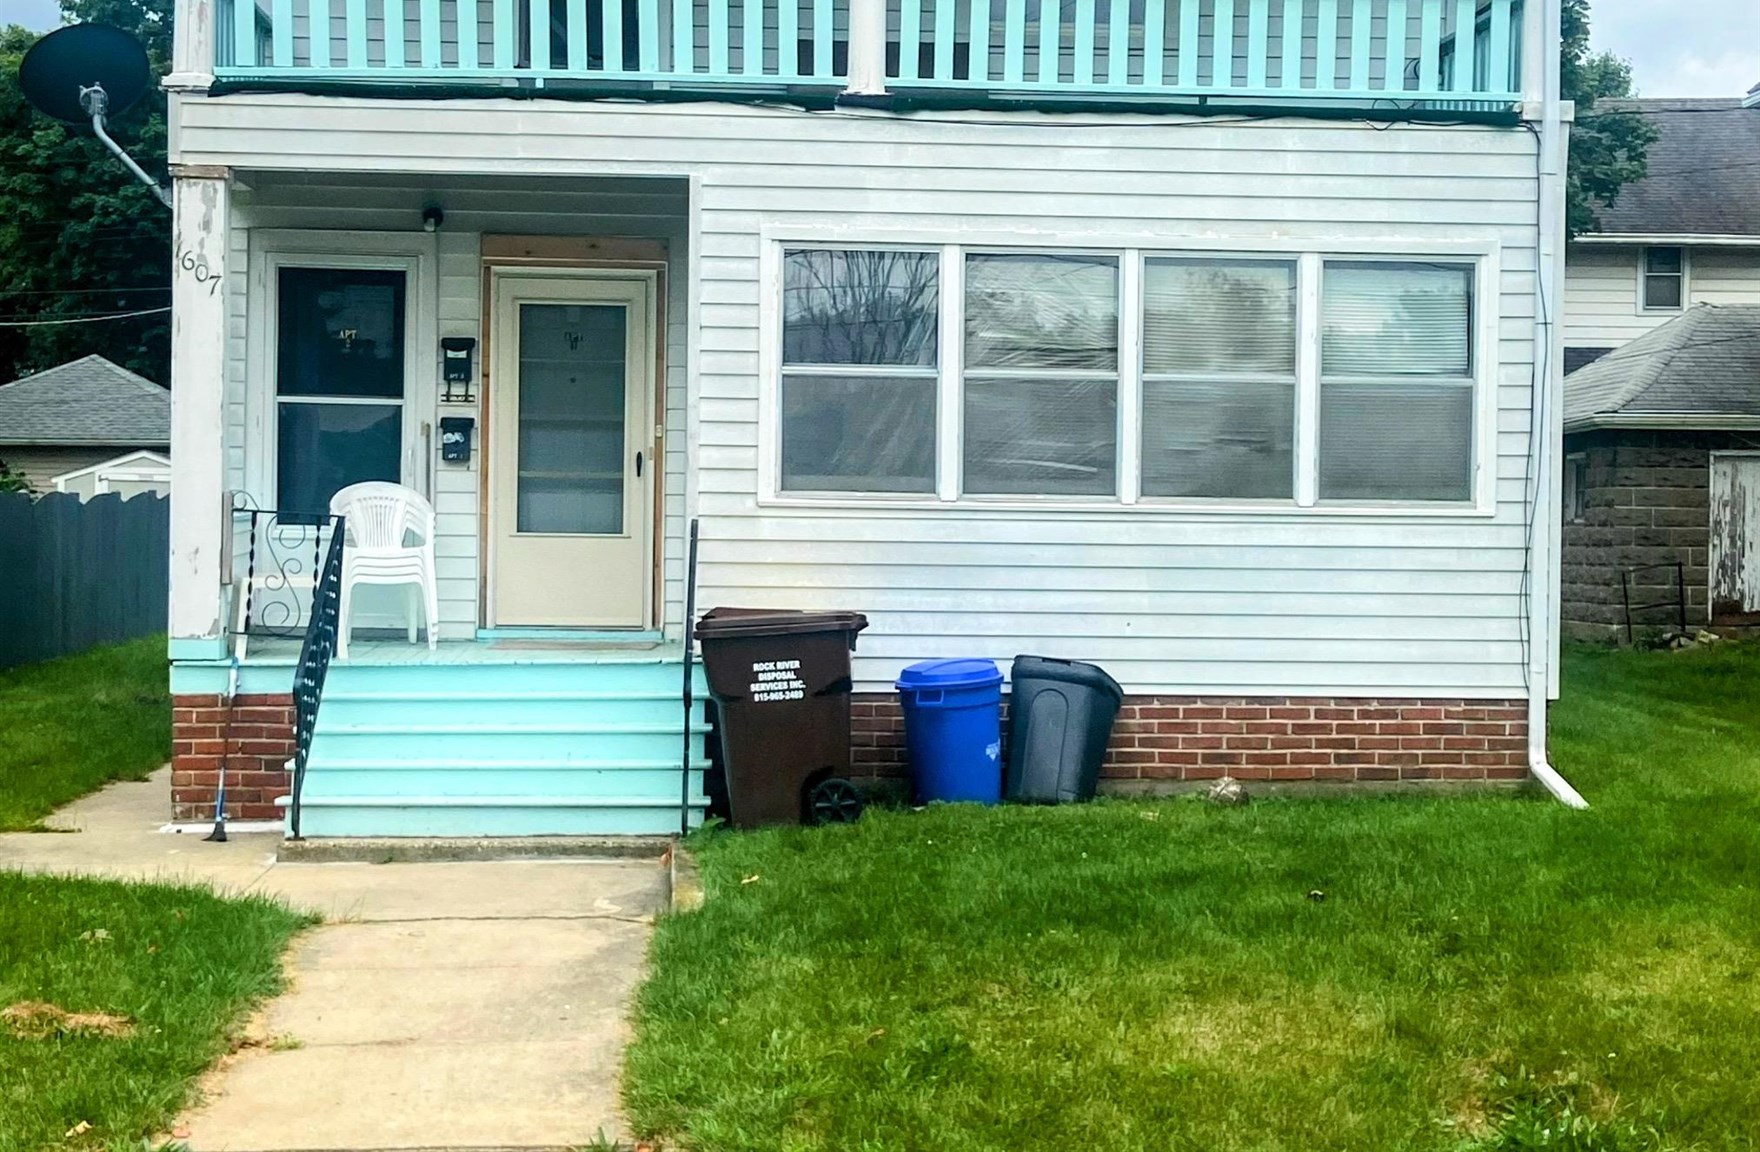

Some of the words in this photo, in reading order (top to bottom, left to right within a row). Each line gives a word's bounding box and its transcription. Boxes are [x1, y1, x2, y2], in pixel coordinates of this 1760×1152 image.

[339, 329, 357, 339] APT
[753, 662, 776, 672] ROCK
[776, 660, 800, 669] RIVER
[758, 670, 797, 681] DISPOSAL
[750, 681, 788, 692] SERVICES
[789, 680, 806, 689] INC.
